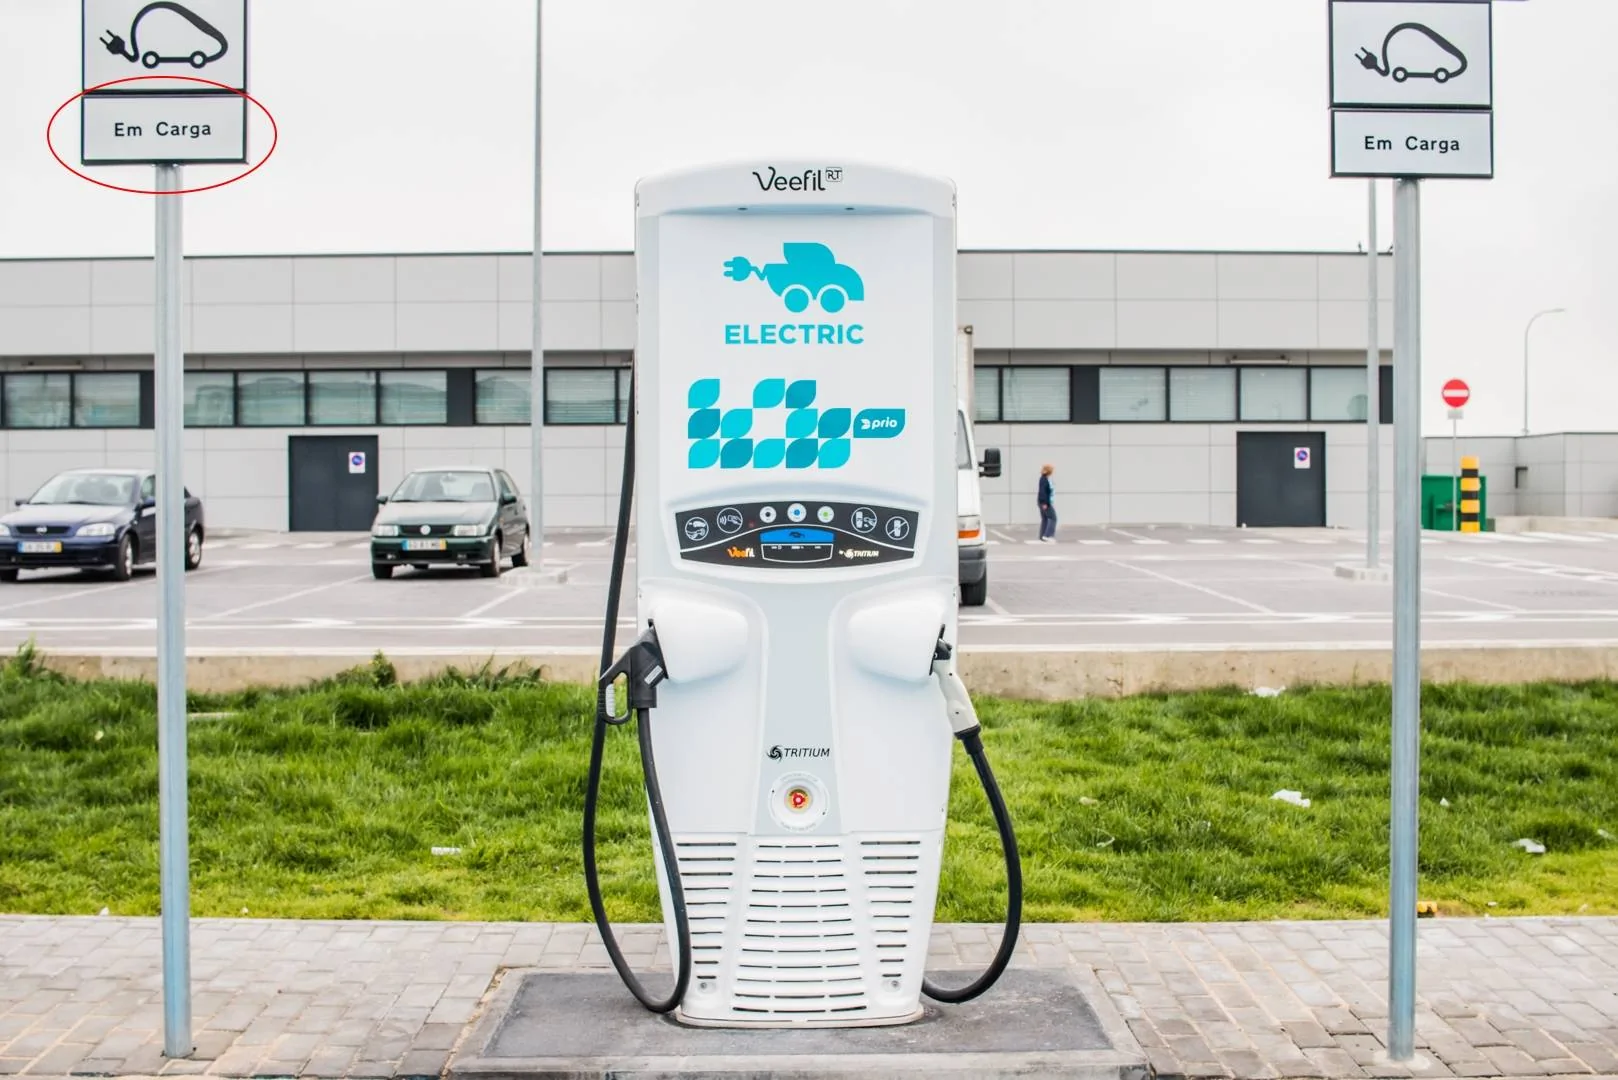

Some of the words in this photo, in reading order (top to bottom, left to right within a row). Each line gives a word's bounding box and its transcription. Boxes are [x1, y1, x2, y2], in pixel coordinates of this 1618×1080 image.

[114, 122, 142, 137] Em
[156, 121, 212, 139] Carga
[1364, 135, 1392, 150] Em
[1405, 135, 1460, 154] Carga
[752, 166, 826, 191] Veefil
[826, 169, 842, 181] RT
[724, 324, 864, 345] ELECTRIC
[871, 416, 898, 430] prio
[784, 747, 831, 758] TRITIUM
